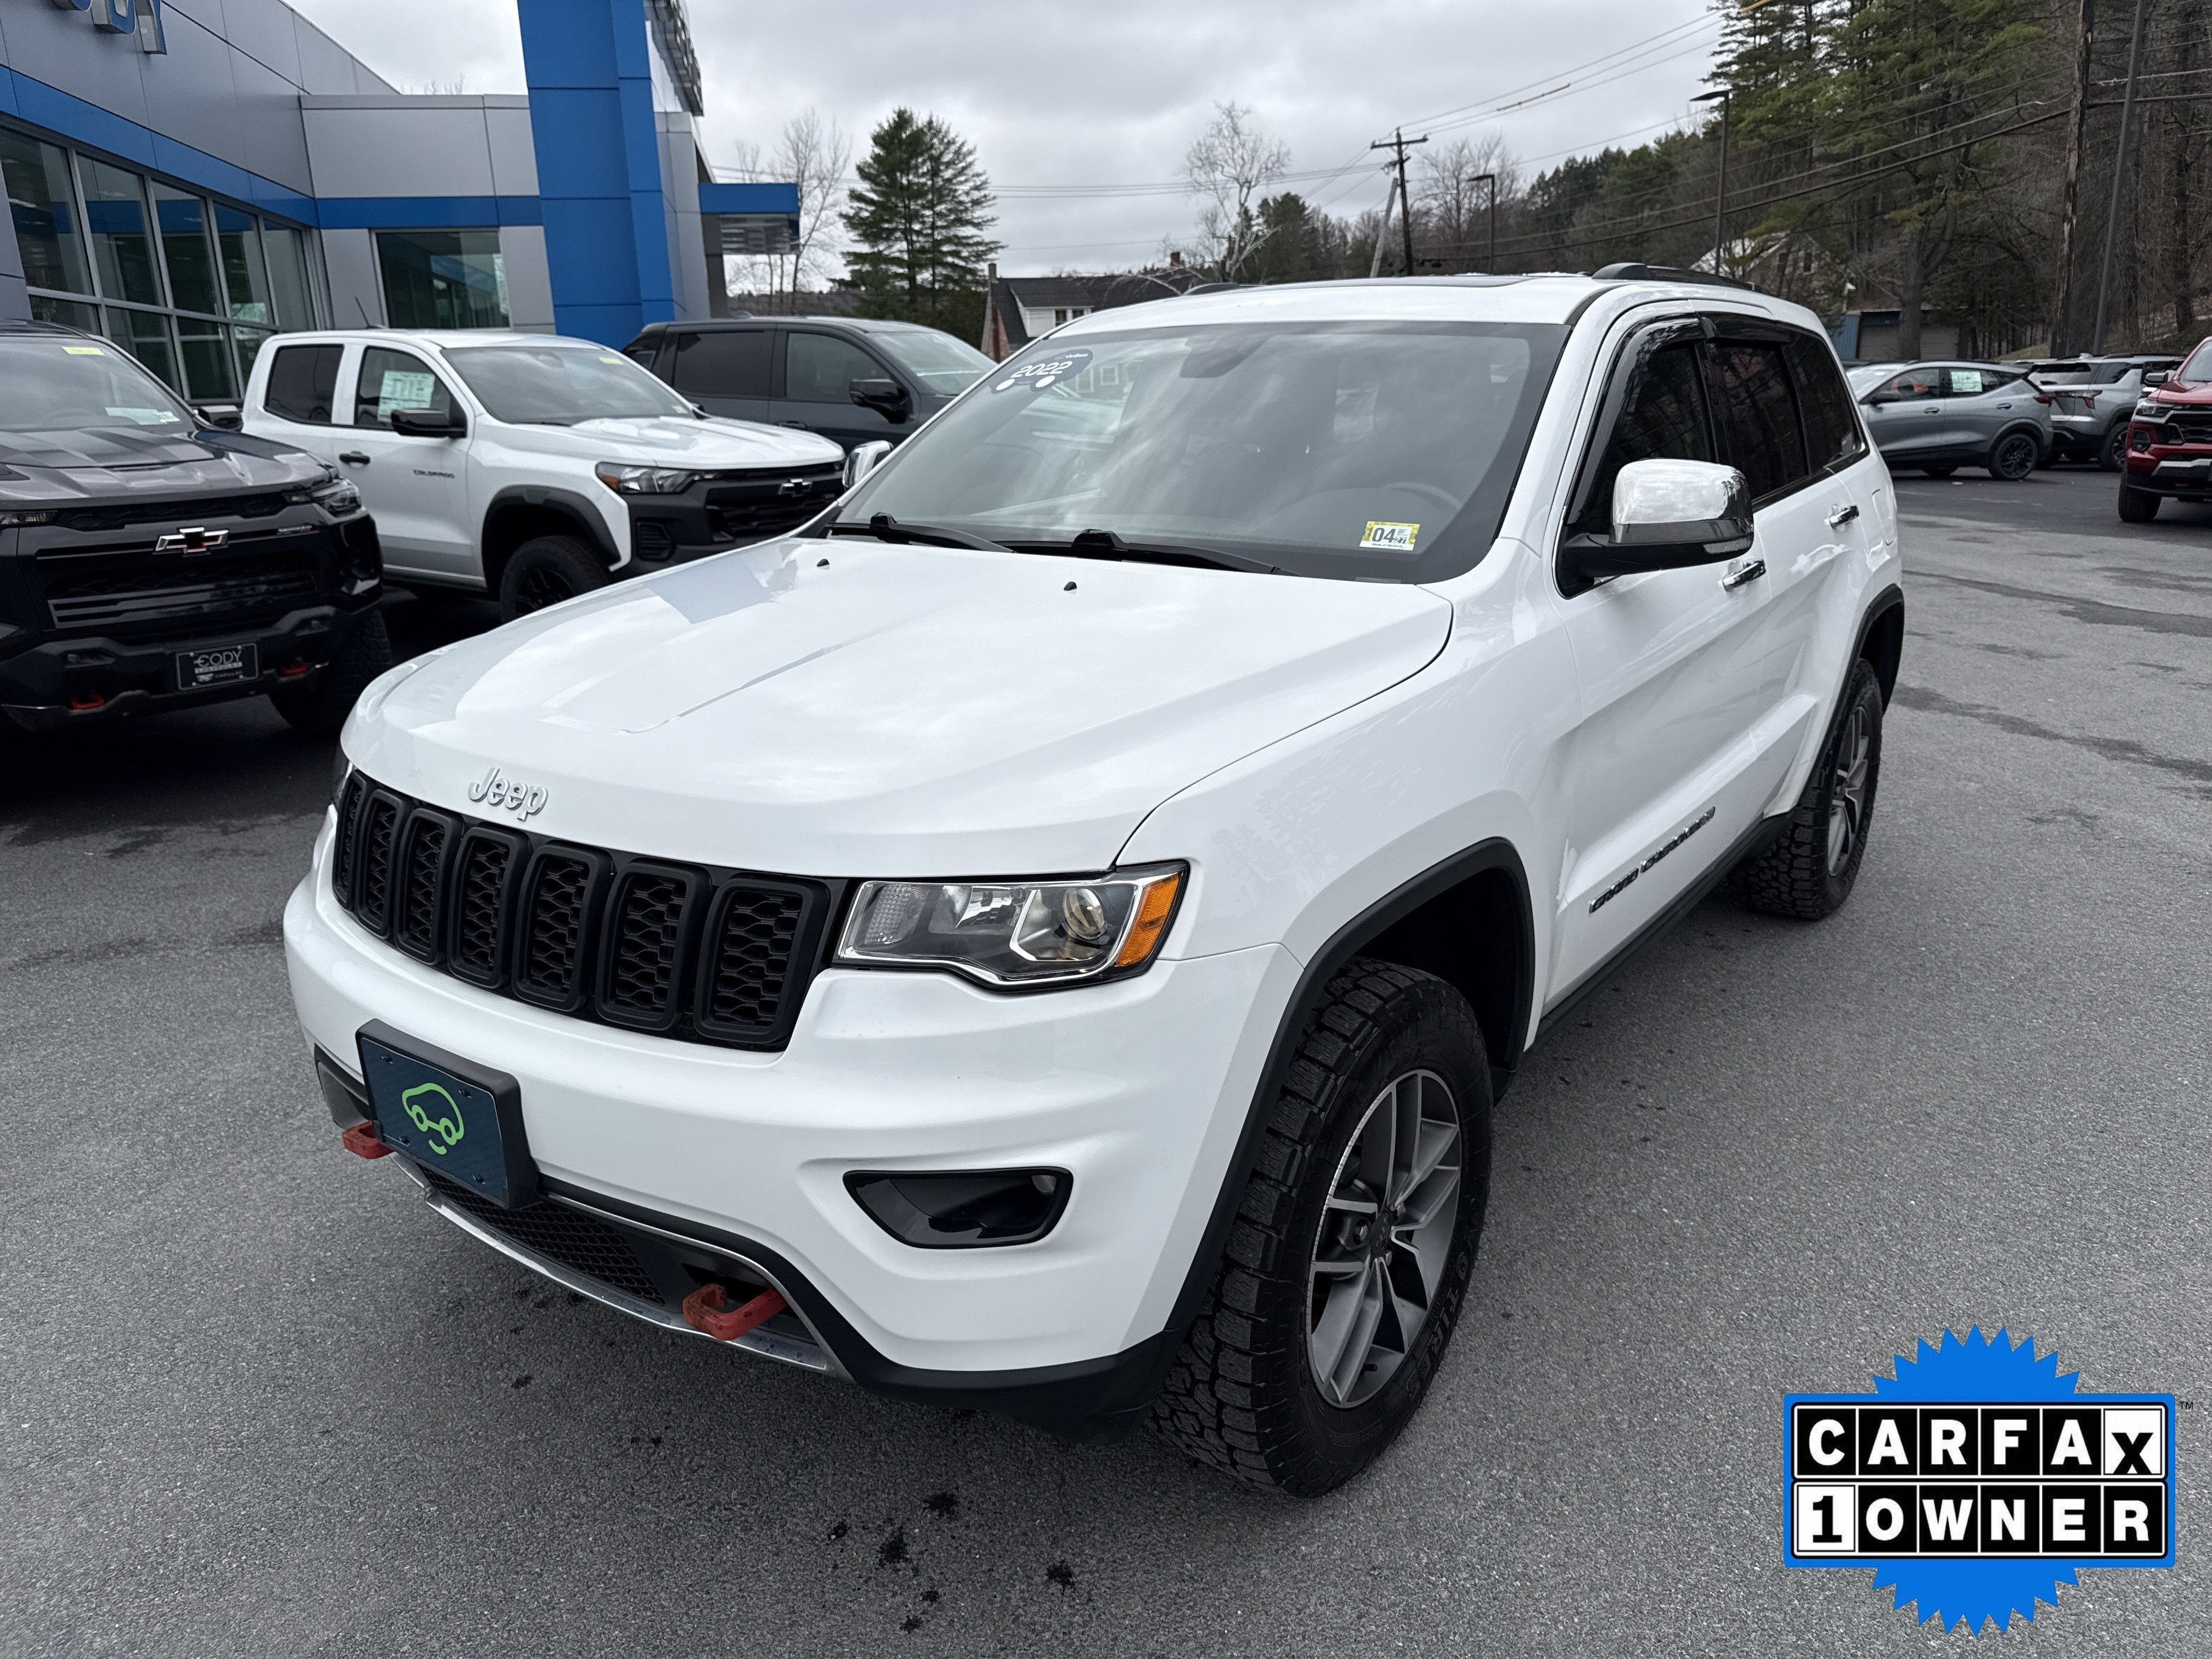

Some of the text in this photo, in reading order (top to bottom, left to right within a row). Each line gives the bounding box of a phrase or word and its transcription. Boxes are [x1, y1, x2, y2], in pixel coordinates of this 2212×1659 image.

[1010, 361, 1073, 378] 2022
[1372, 527, 1396, 543] 04
[198, 649, 242, 668] CODY
[468, 768, 549, 822] Jeep
[1406, 1287, 1459, 1403] TIRES
